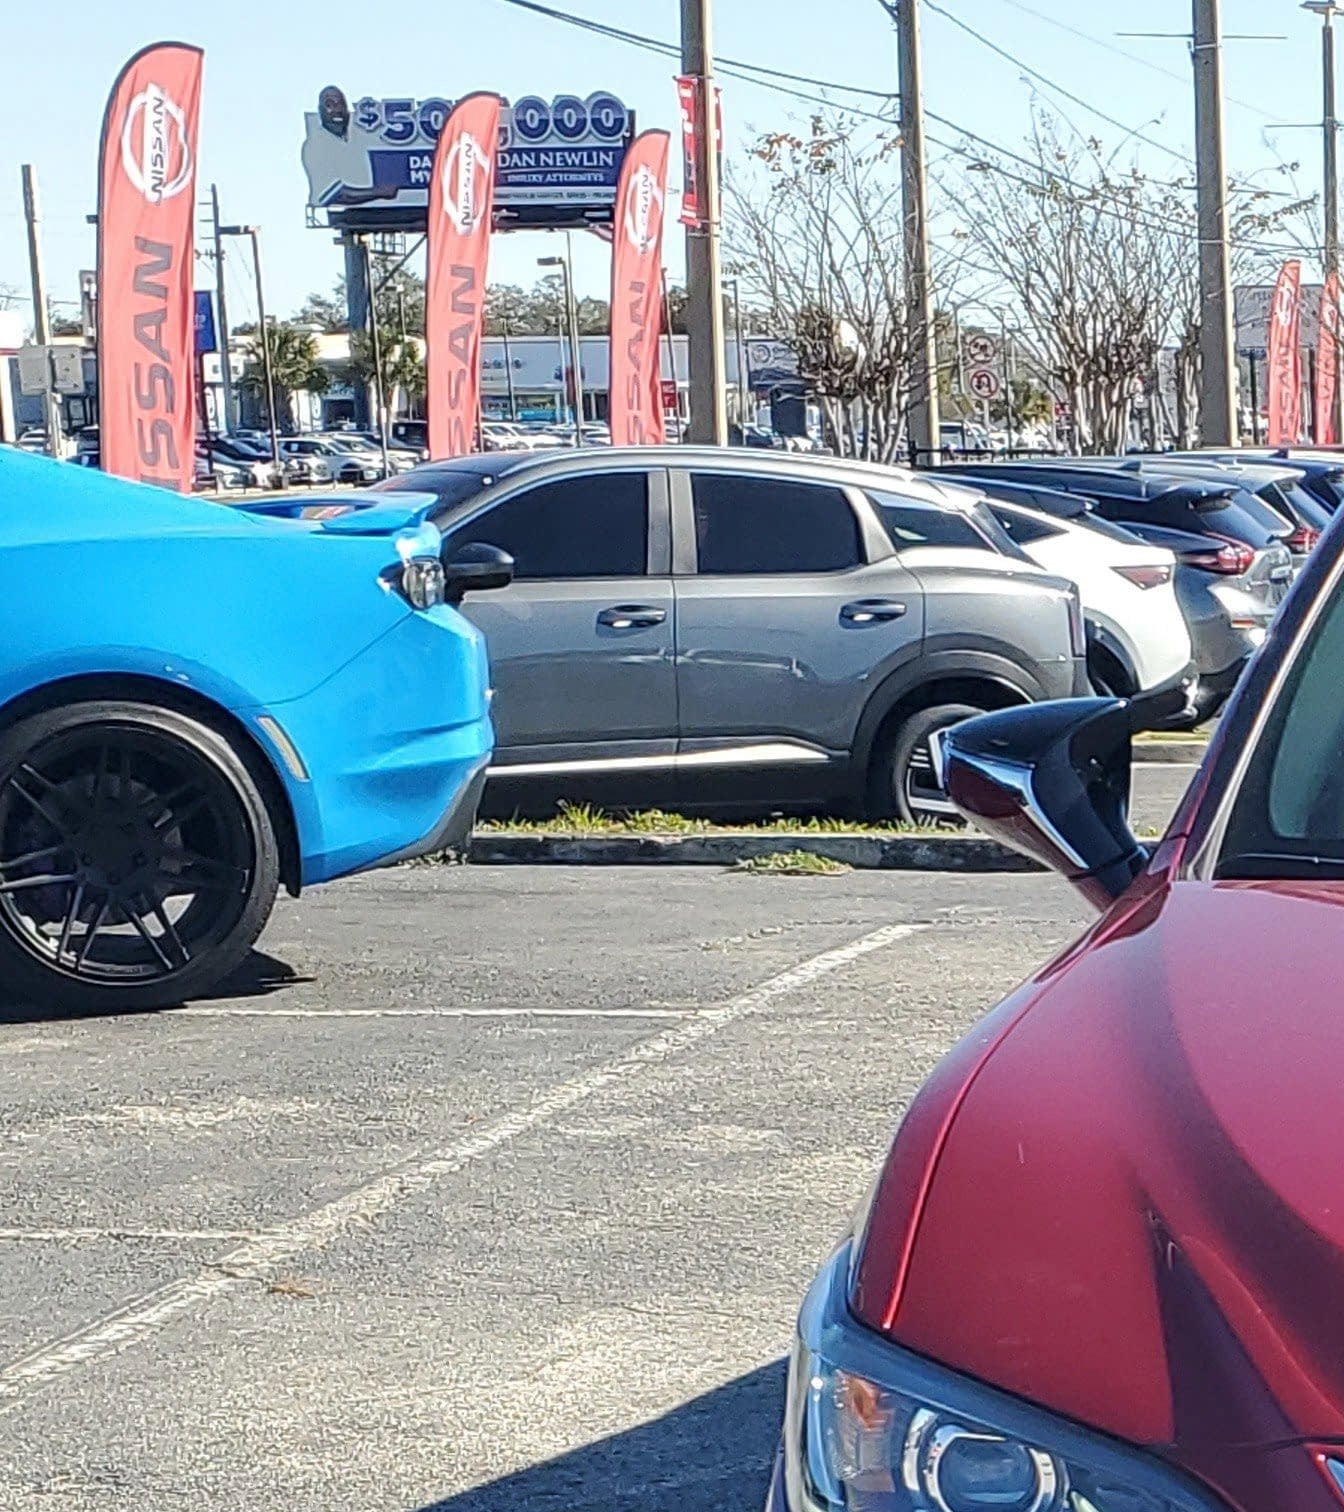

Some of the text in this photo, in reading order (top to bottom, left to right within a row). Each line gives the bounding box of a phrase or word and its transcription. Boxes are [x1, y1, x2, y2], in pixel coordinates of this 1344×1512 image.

[150, 97, 164, 206] NISSAN
[356, 92, 628, 149] $50,000
[497, 151, 614, 168] DAN NEWLIN
[132, 236, 183, 491] ISSAN
